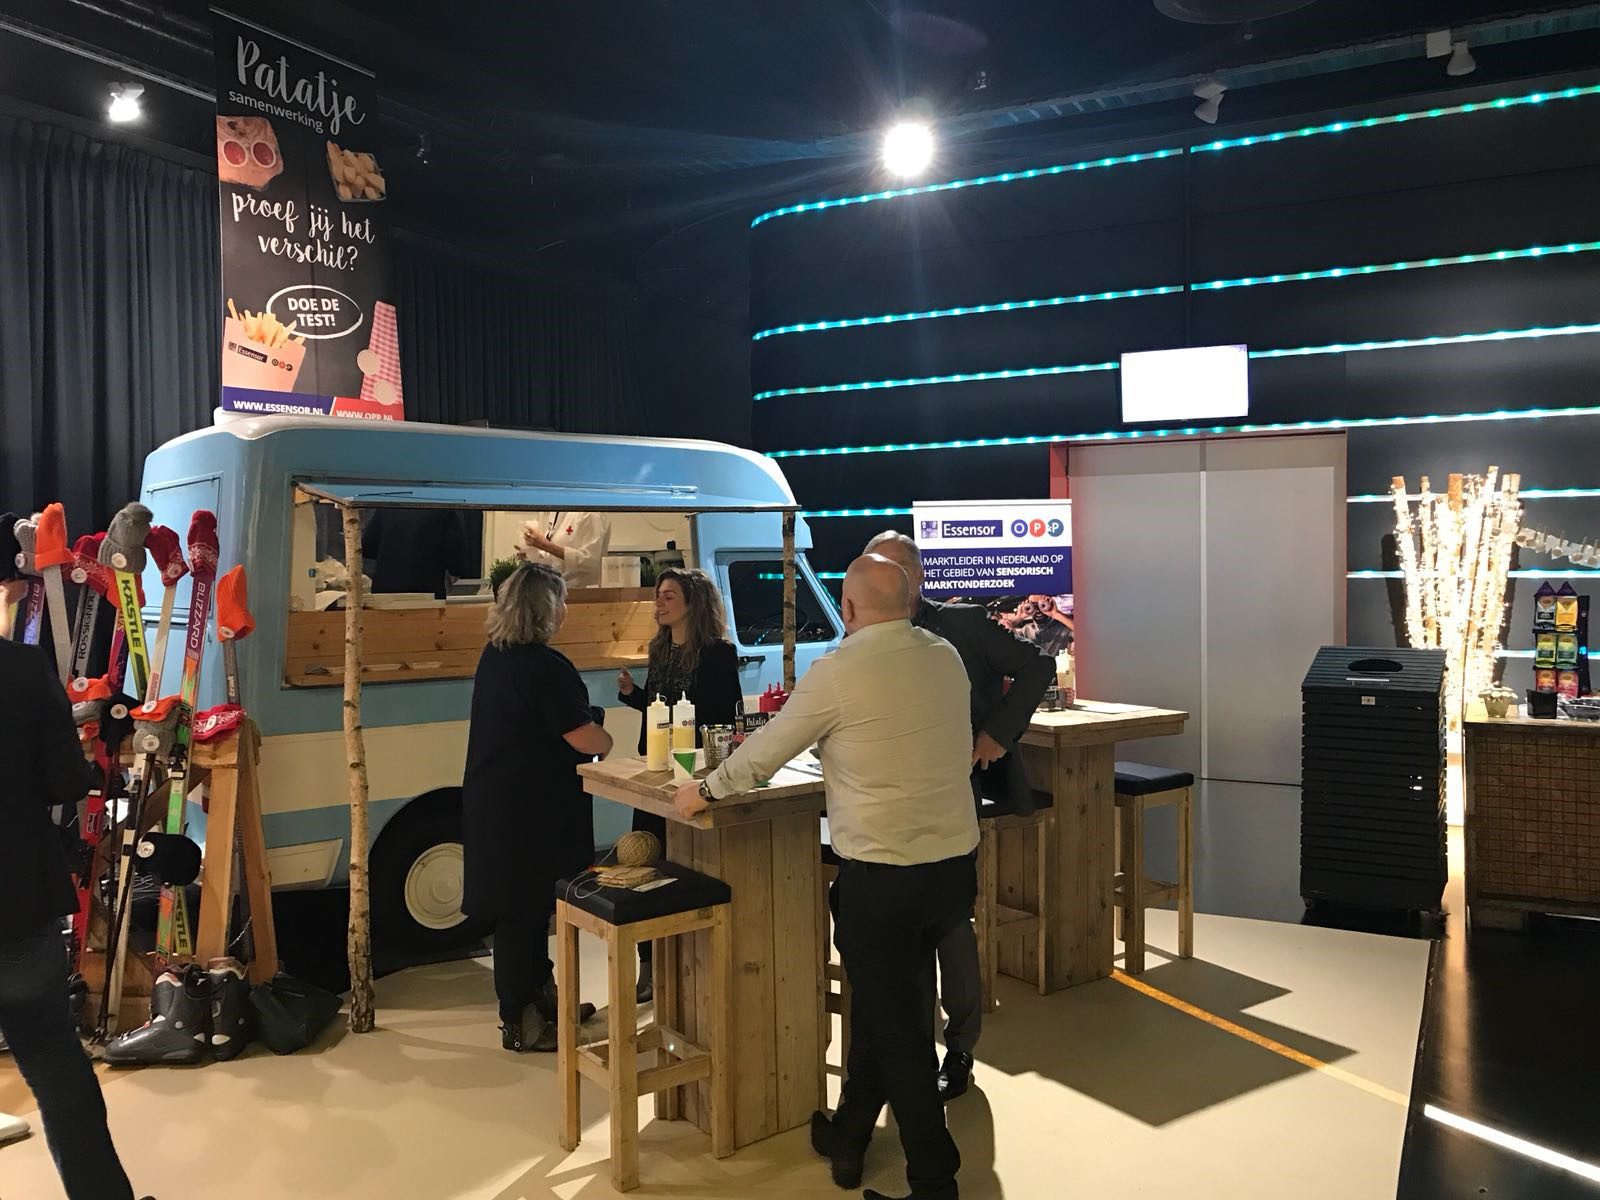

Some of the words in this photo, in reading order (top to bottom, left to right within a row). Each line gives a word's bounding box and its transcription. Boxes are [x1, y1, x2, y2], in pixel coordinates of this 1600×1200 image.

[237, 35, 366, 135] Patatje
[229, 90, 324, 134] samenwerking
[231, 192, 299, 234] proef
[308, 204, 335, 242] jij
[341, 211, 375, 244] het
[258, 235, 358, 271] verschil?
[287, 297, 319, 312] DOE
[321, 299, 340, 312] DE
[297, 313, 336, 327] TEST!
[233, 400, 325, 416] WWW.ESSENSOR.NL
[943, 523, 996, 537] Essensor
[923, 556, 984, 566] MARKTLEIDER
[985, 556, 995, 565] IN
[996, 555, 1050, 564] NEDERLAND
[1050, 554, 1064, 564] OP
[924, 569, 940, 578] HET
[942, 568, 975, 578] GEBIED
[977, 568, 995, 577] VAN
[996, 566, 1054, 576] SENSORISCH
[924, 579, 1015, 590] MARKTONDERZOEK
[191, 582, 206, 649] BLIZZARD
